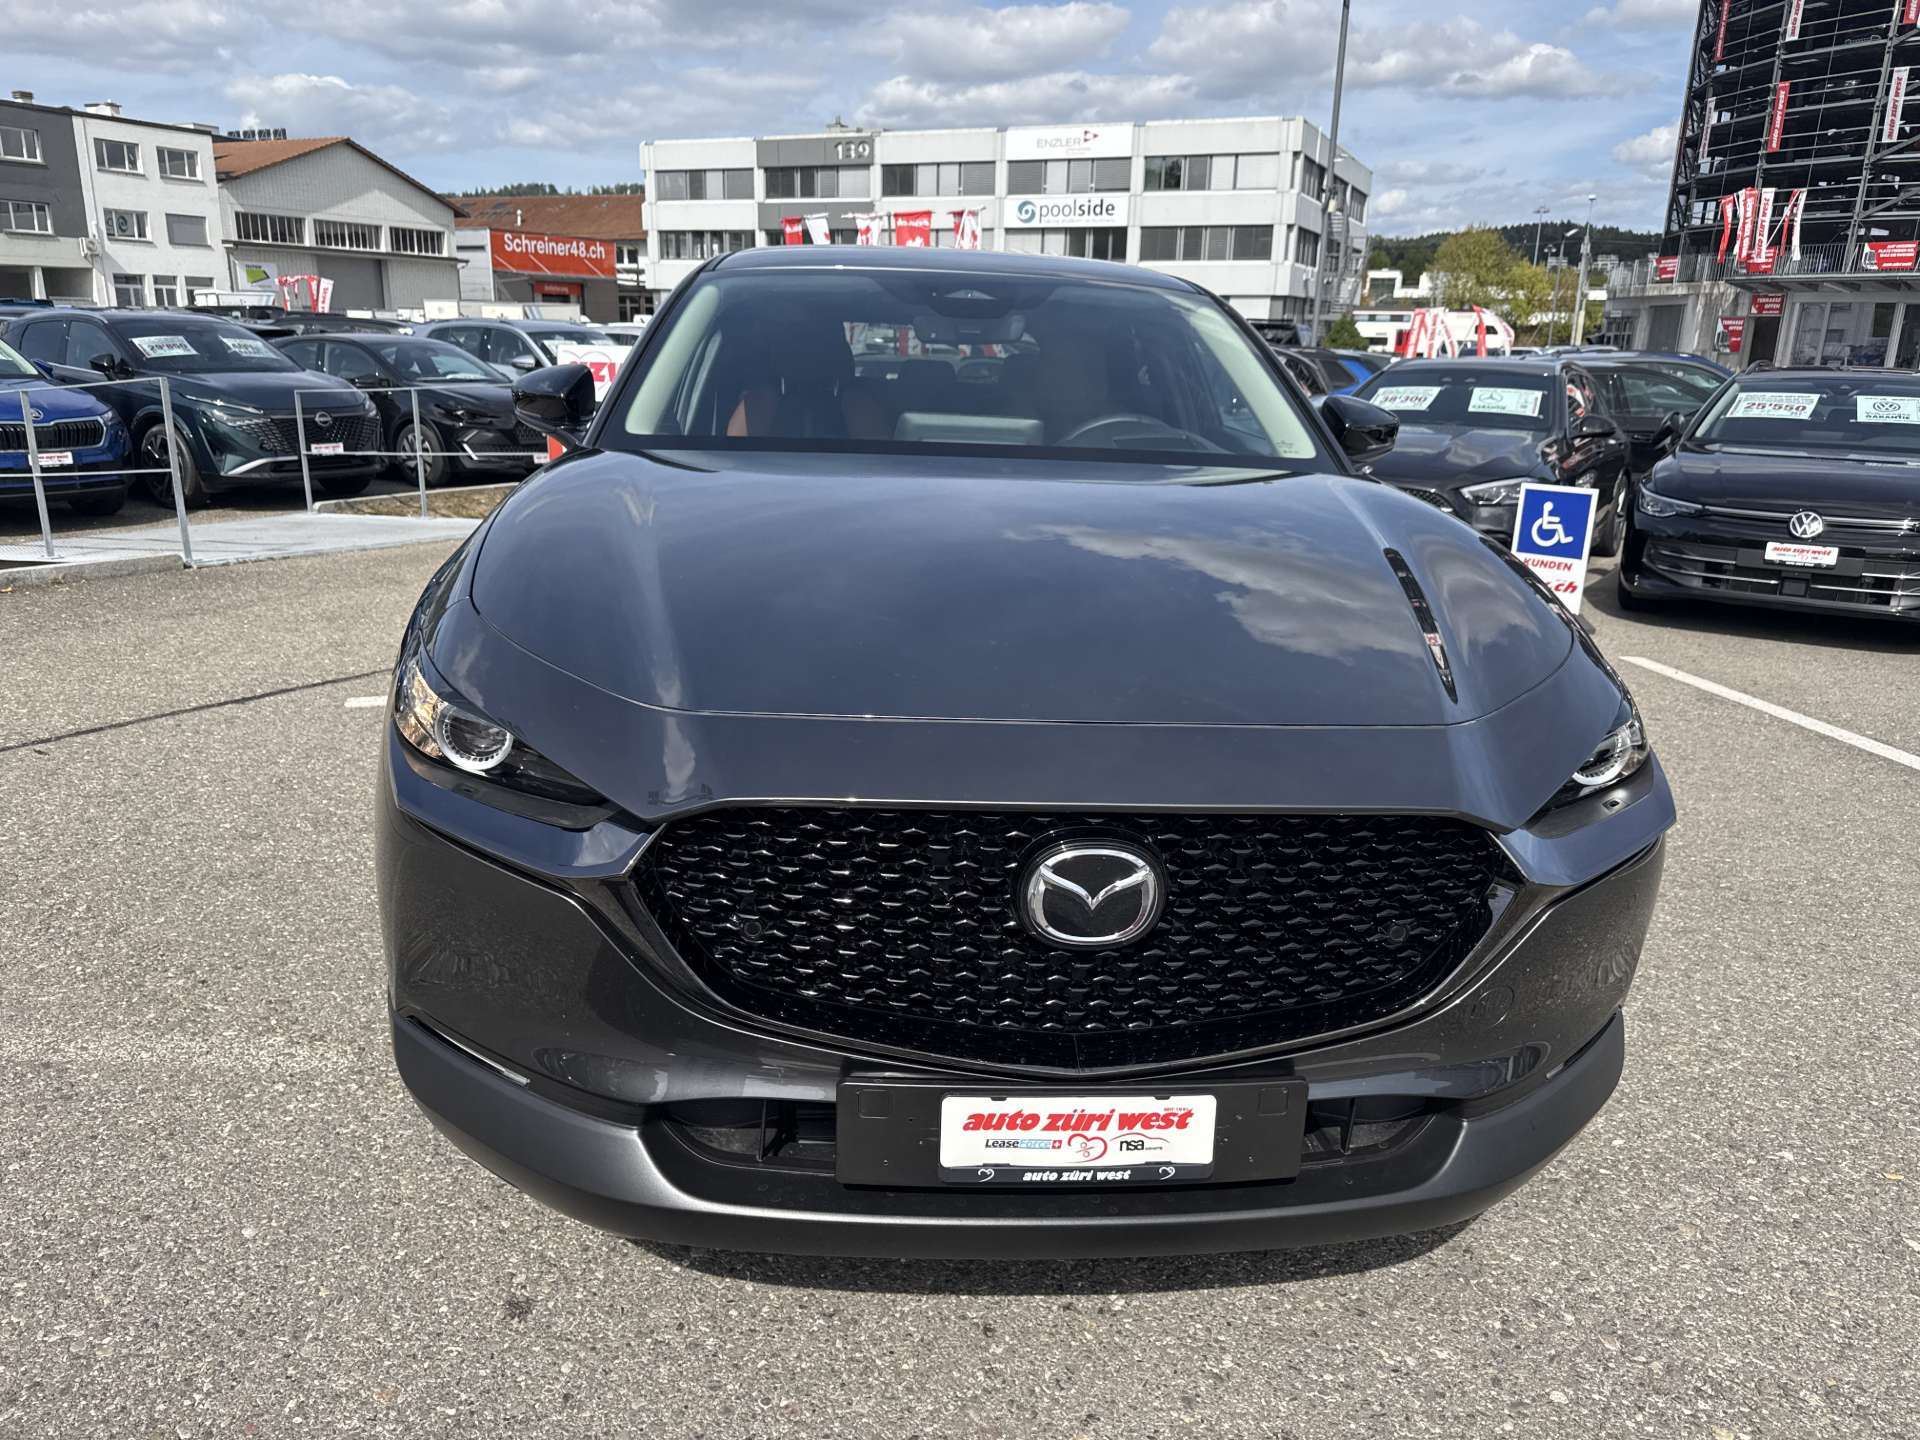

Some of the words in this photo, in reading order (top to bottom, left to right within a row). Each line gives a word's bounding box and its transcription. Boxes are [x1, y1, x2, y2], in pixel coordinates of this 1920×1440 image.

[1037, 137, 1081, 148] ENZLER
[1039, 198, 1115, 223] poolside
[503, 232, 606, 259] Schreiner48.ch
[1744, 402, 1807, 412] 25'550
[1523, 557, 1573, 572] KUNDEN
[962, 1109, 1041, 1131] auto
[1041, 1108, 1115, 1132] züri
[1117, 1108, 1195, 1131] west
[1119, 1139, 1145, 1151] nsa
[1023, 1169, 1057, 1181] auto
[1060, 1169, 1093, 1181] züri
[1096, 1169, 1132, 1180] west
